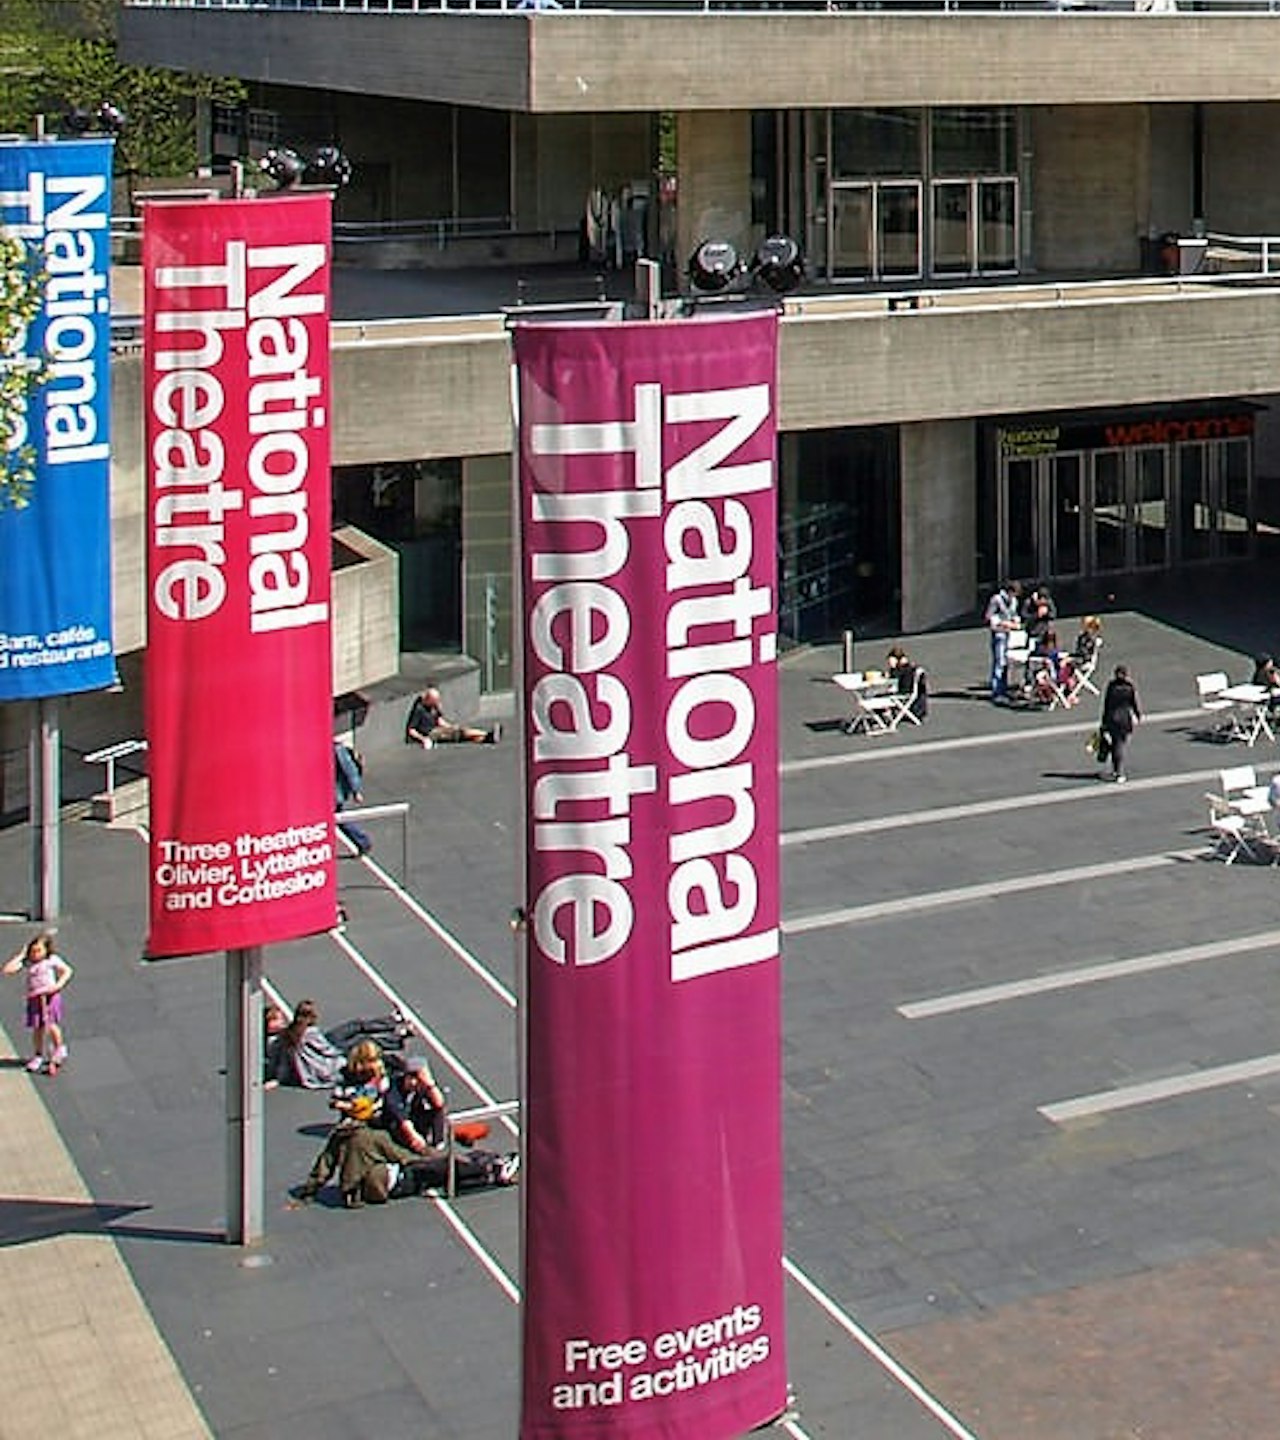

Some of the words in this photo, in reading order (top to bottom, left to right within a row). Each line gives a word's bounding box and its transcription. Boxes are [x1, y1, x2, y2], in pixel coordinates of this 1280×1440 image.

[45, 175, 109, 464] National
[153, 240, 246, 622] Theatre
[246, 243, 328, 632] National
[998, 424, 1060, 445] National
[1104, 416, 1254, 445] welcome
[11, 640, 111, 668] restaurants
[45, 625, 95, 646] cafés
[531, 383, 661, 966] Theatre
[664, 383, 779, 981] National
[155, 863, 236, 886] Olivier,
[241, 844, 332, 880] Lyttelton
[158, 840, 231, 862] Three
[235, 822, 328, 856] theatres
[166, 888, 212, 910] and
[217, 870, 327, 906] Cottesloe
[565, 1340, 647, 1372] Free
[654, 1304, 761, 1359] events
[553, 1372, 622, 1408] and
[629, 1335, 769, 1400] activities
